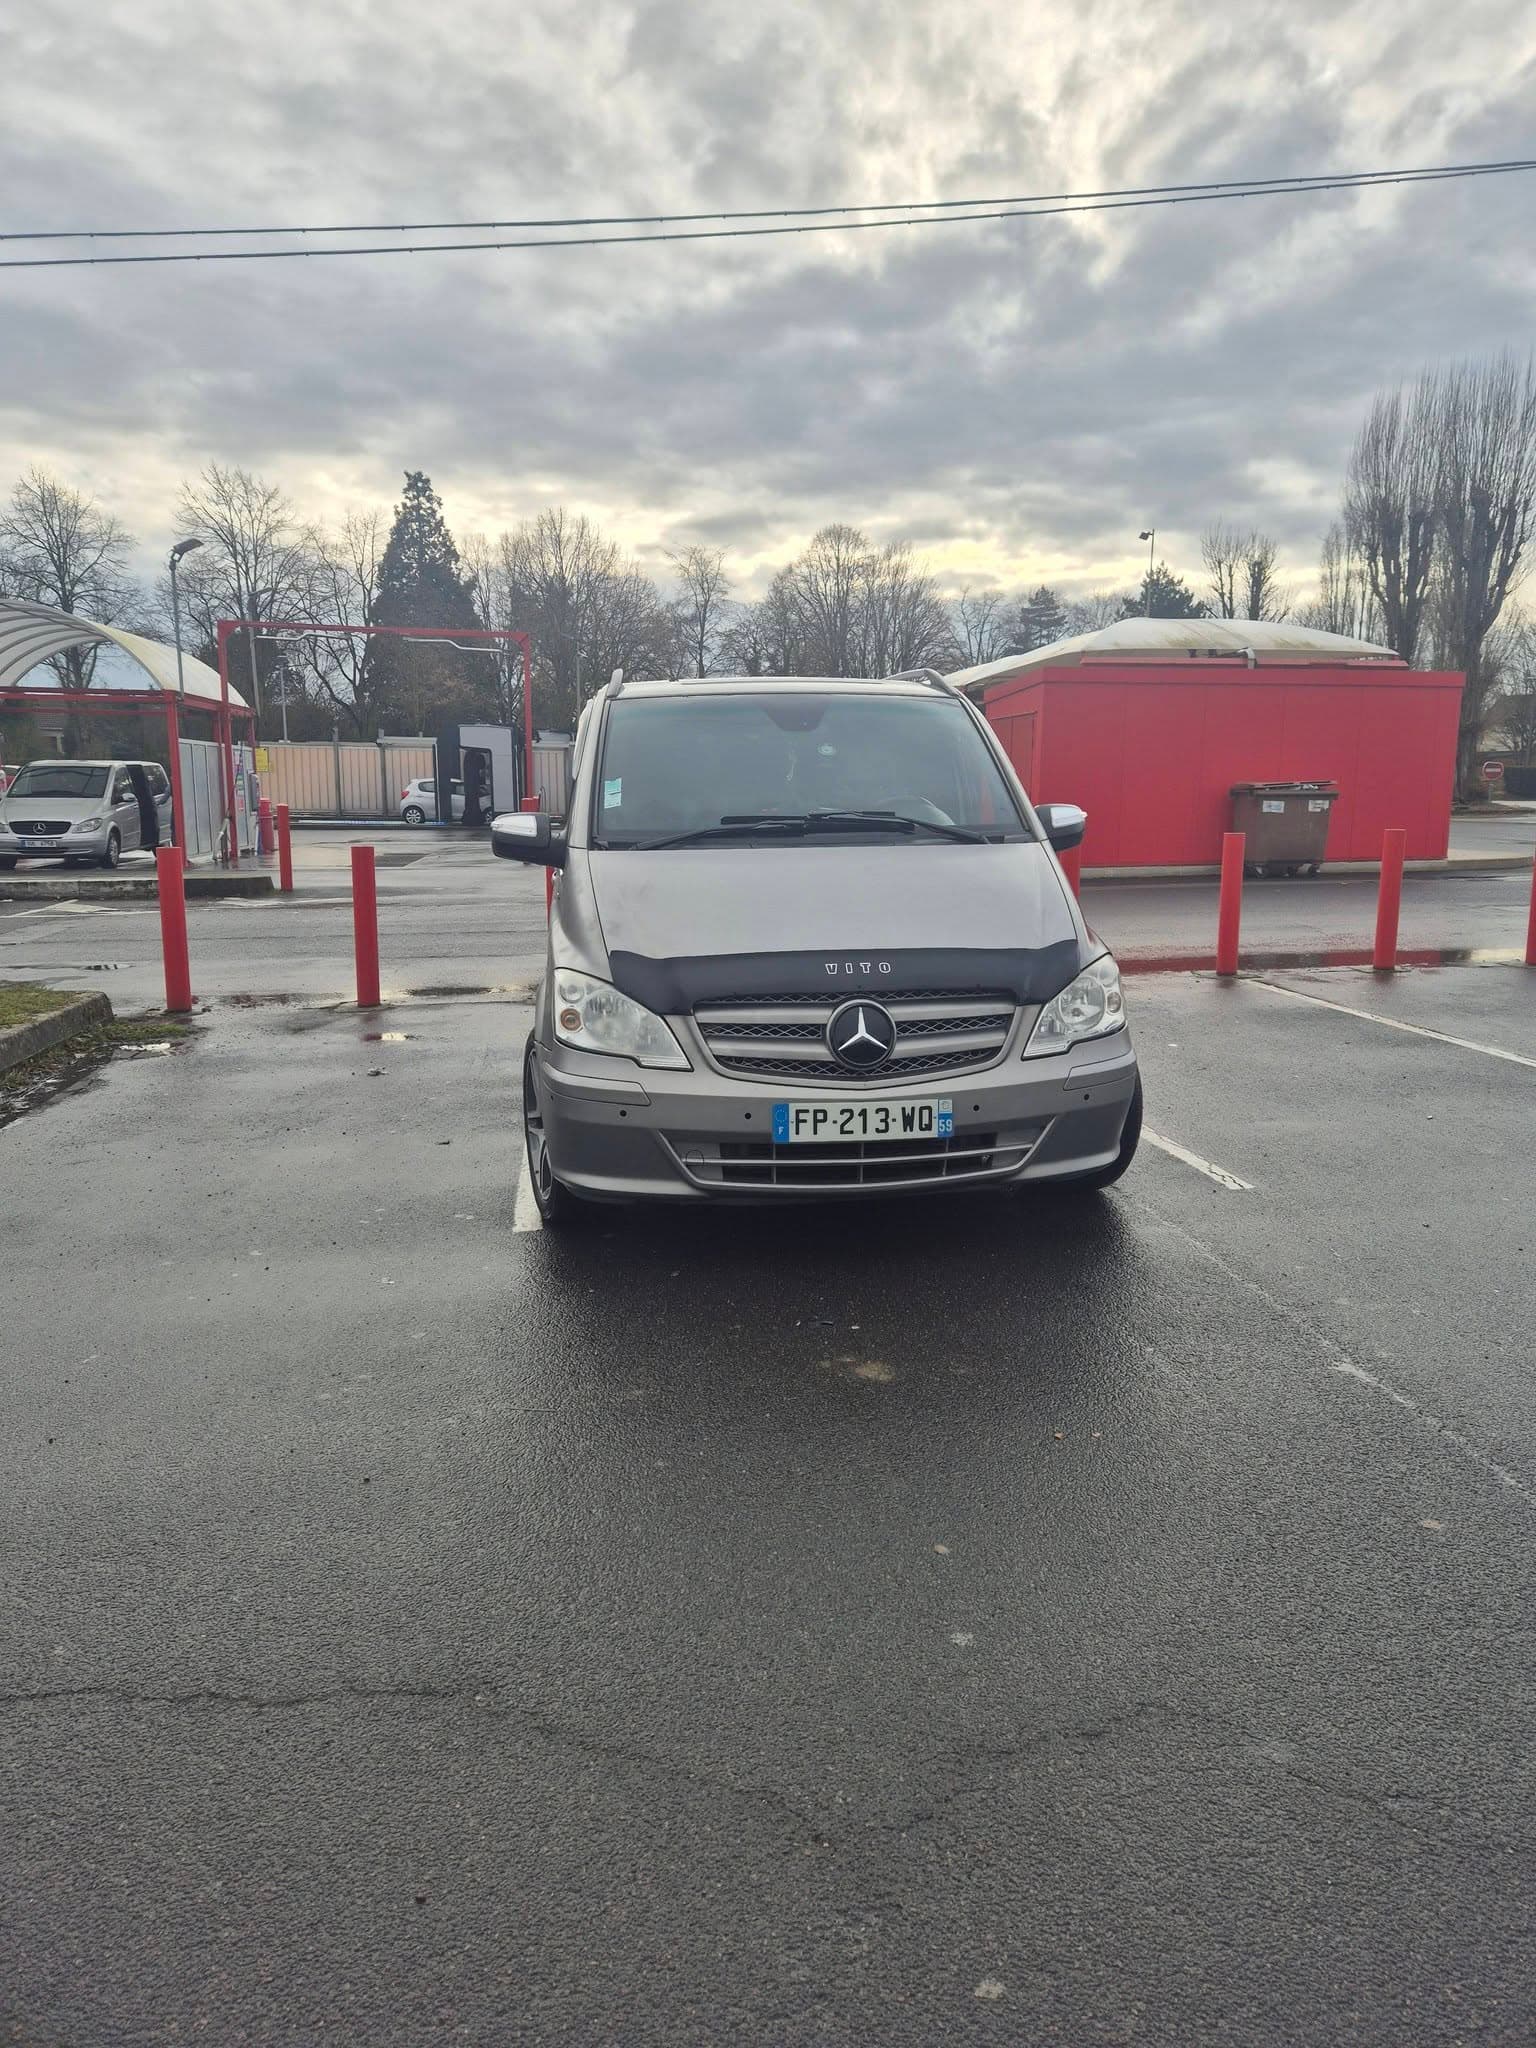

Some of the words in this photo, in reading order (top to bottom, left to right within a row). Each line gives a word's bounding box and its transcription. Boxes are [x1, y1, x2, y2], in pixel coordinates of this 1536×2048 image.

[825, 962, 891, 974] VITO
[778, 1126, 784, 1135] F
[795, 1105, 933, 1135] FP-213-WQ
[939, 1119, 953, 1132] 59
